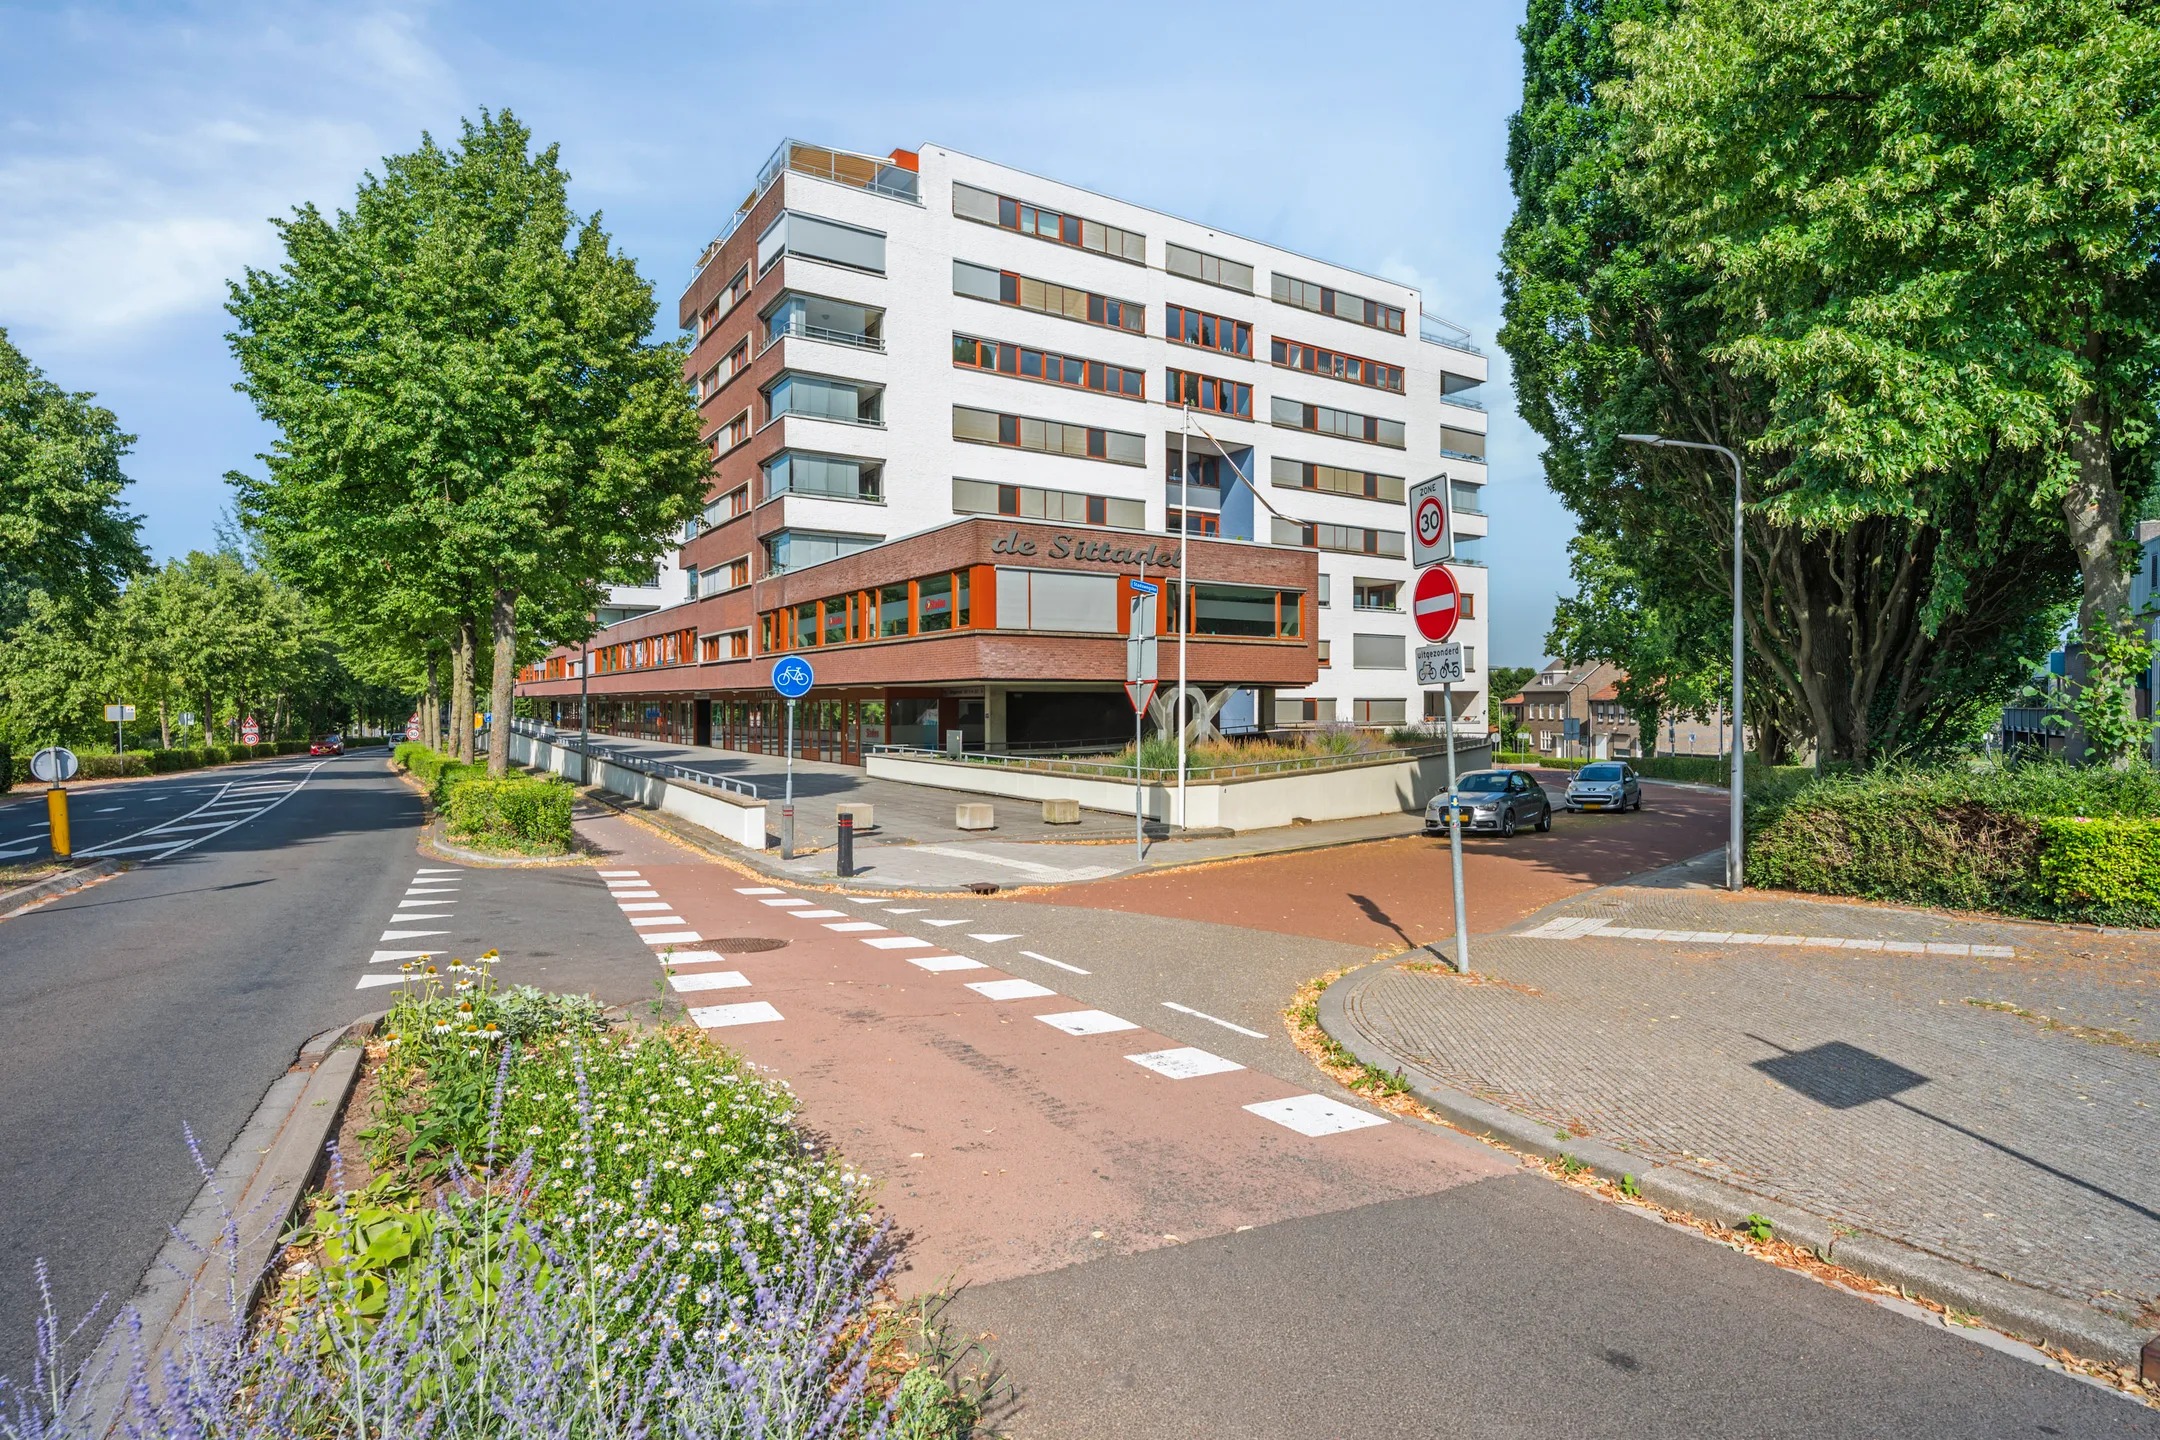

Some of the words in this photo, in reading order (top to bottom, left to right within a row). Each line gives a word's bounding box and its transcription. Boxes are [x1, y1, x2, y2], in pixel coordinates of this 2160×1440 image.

[1420, 484, 1436, 496] ZONE
[1421, 510, 1439, 533] 30
[991, 528, 1038, 556] de
[1048, 534, 1182, 569] Sittadel
[1417, 646, 1459, 660] uitgezonderd
